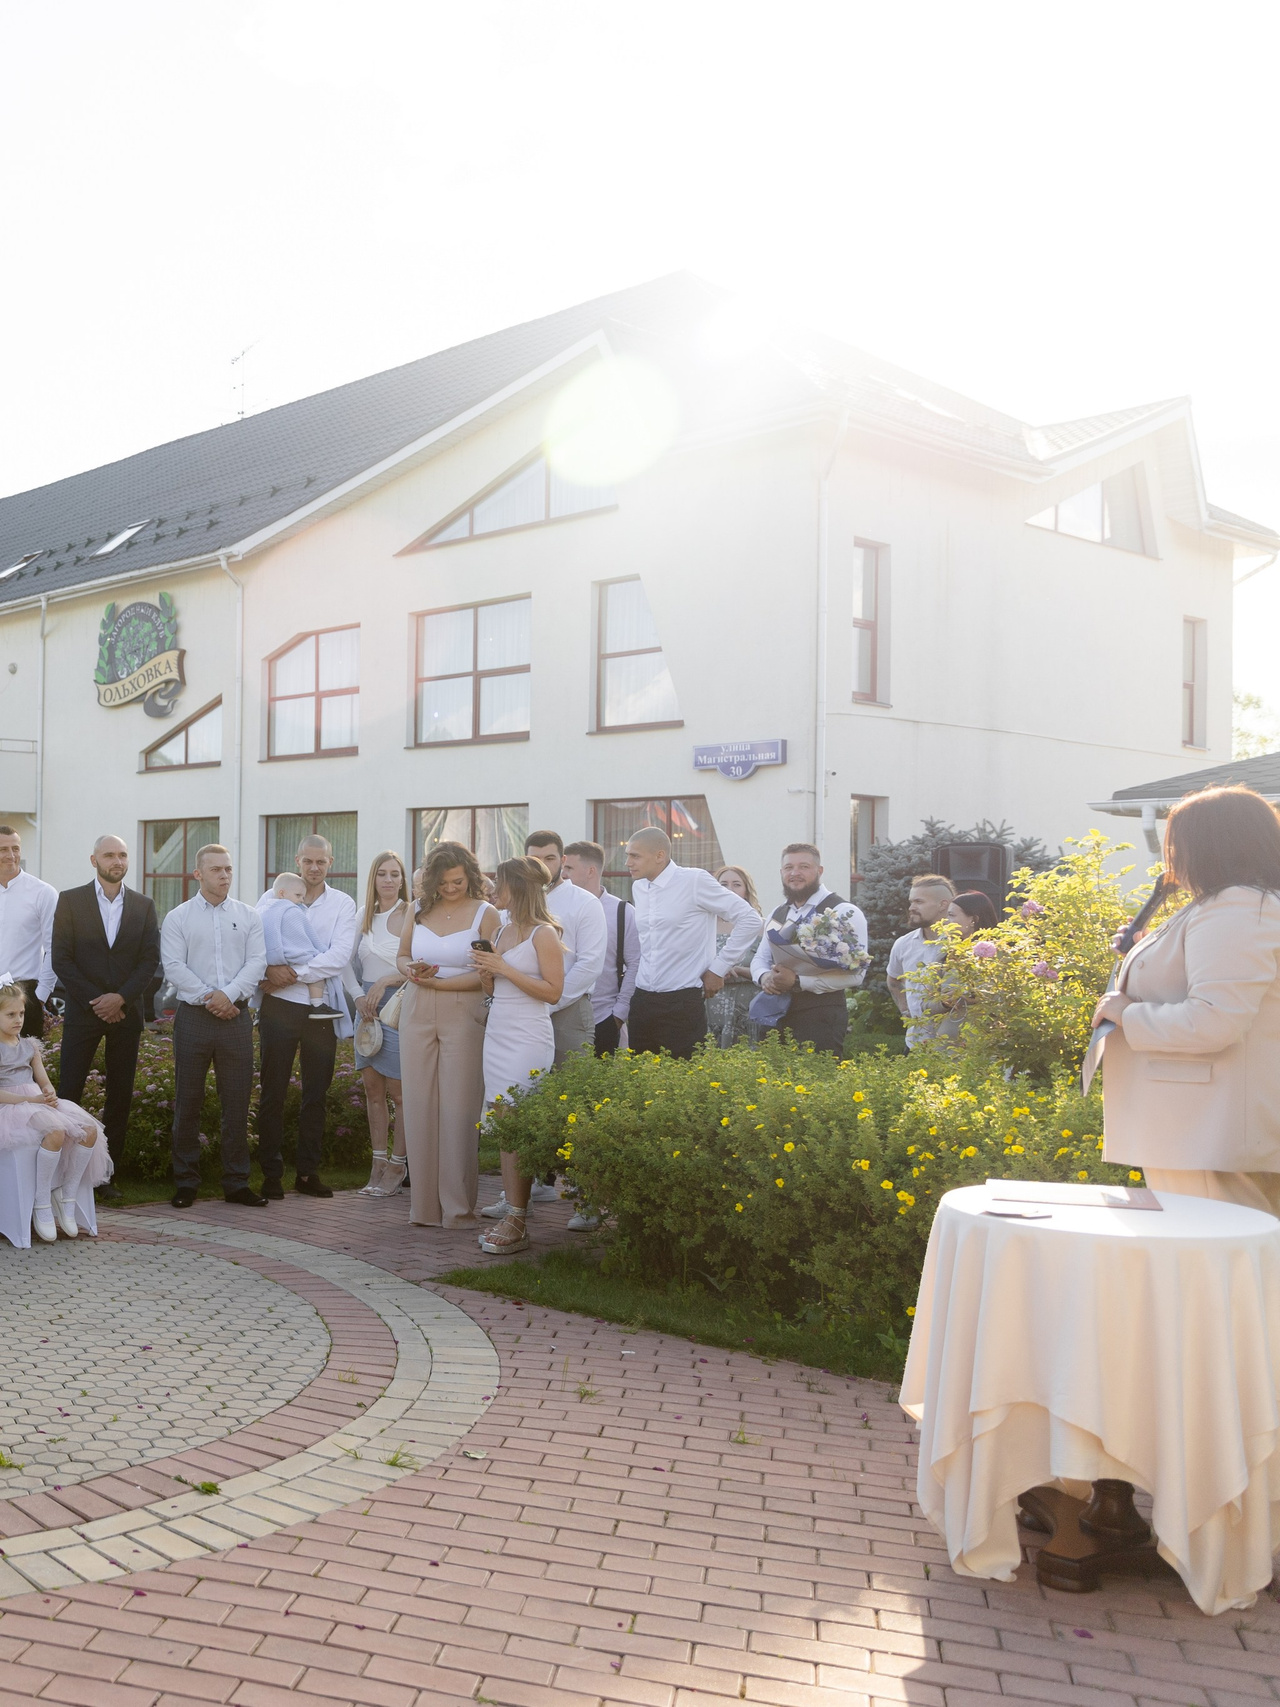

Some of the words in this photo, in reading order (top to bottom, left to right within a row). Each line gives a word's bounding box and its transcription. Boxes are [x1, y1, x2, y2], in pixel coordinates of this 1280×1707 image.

[151, 612, 166, 639] КЛУБ
[103, 659, 173, 704] ОЛЬХОВКА
[721, 743, 751, 755] улица
[697, 752, 776, 765] Магистральная
[729, 766, 743, 777] 30
